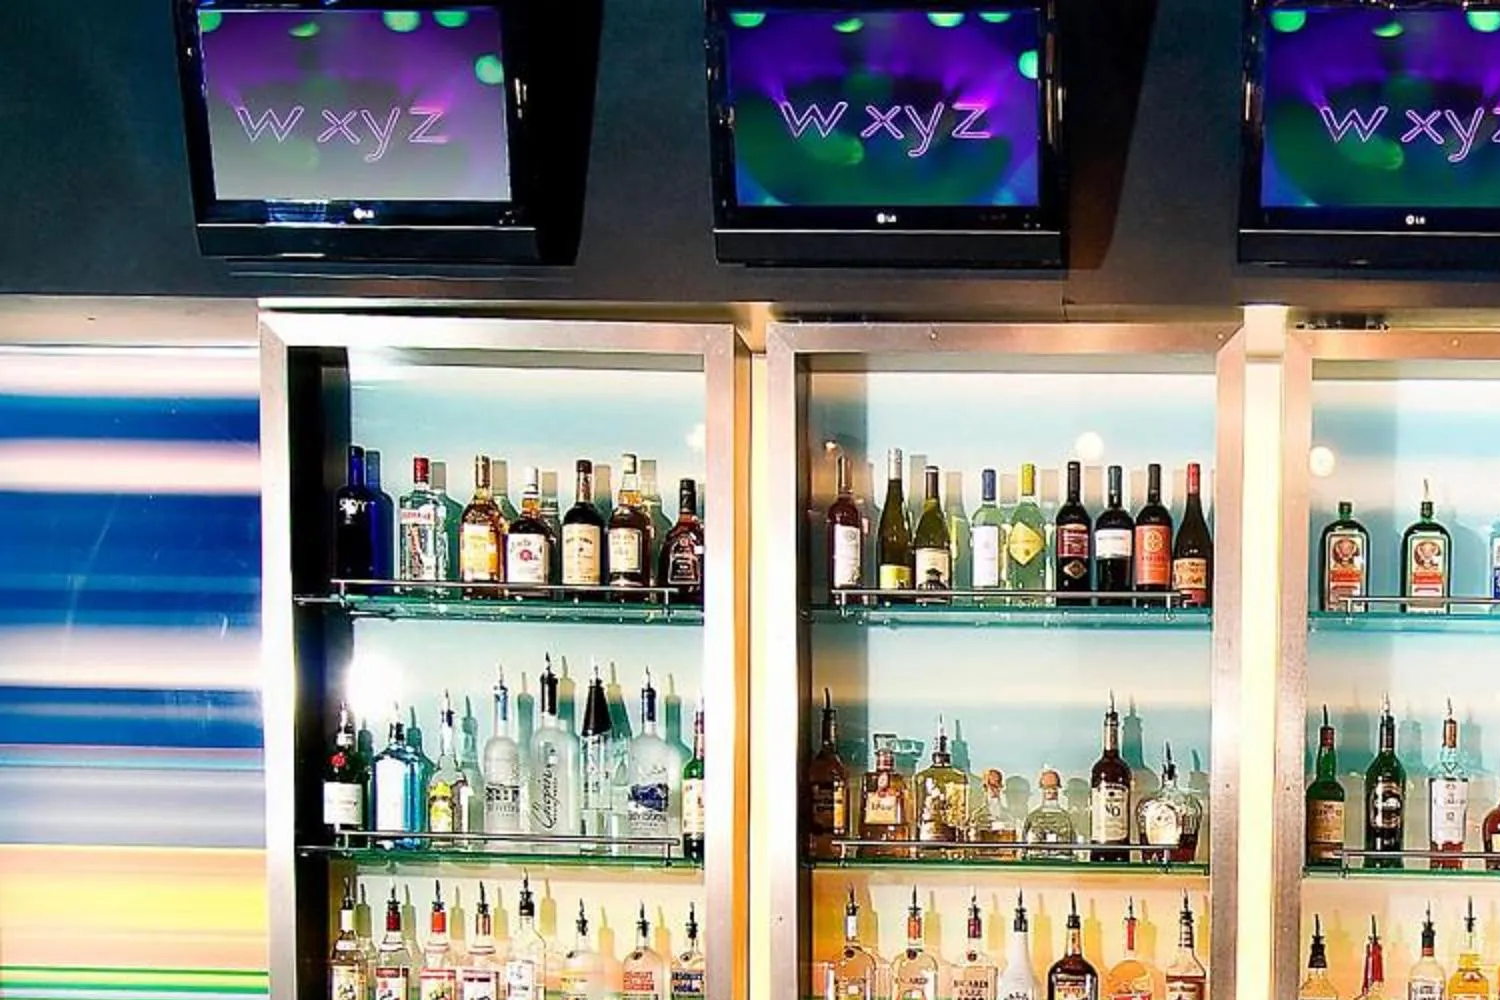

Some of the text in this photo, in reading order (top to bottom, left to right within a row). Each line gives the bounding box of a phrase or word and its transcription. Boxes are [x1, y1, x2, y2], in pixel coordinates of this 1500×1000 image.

[235, 105, 449, 162] w xyz
[780, 101, 992, 157] w xyz
[1320, 105, 1389, 142] w
